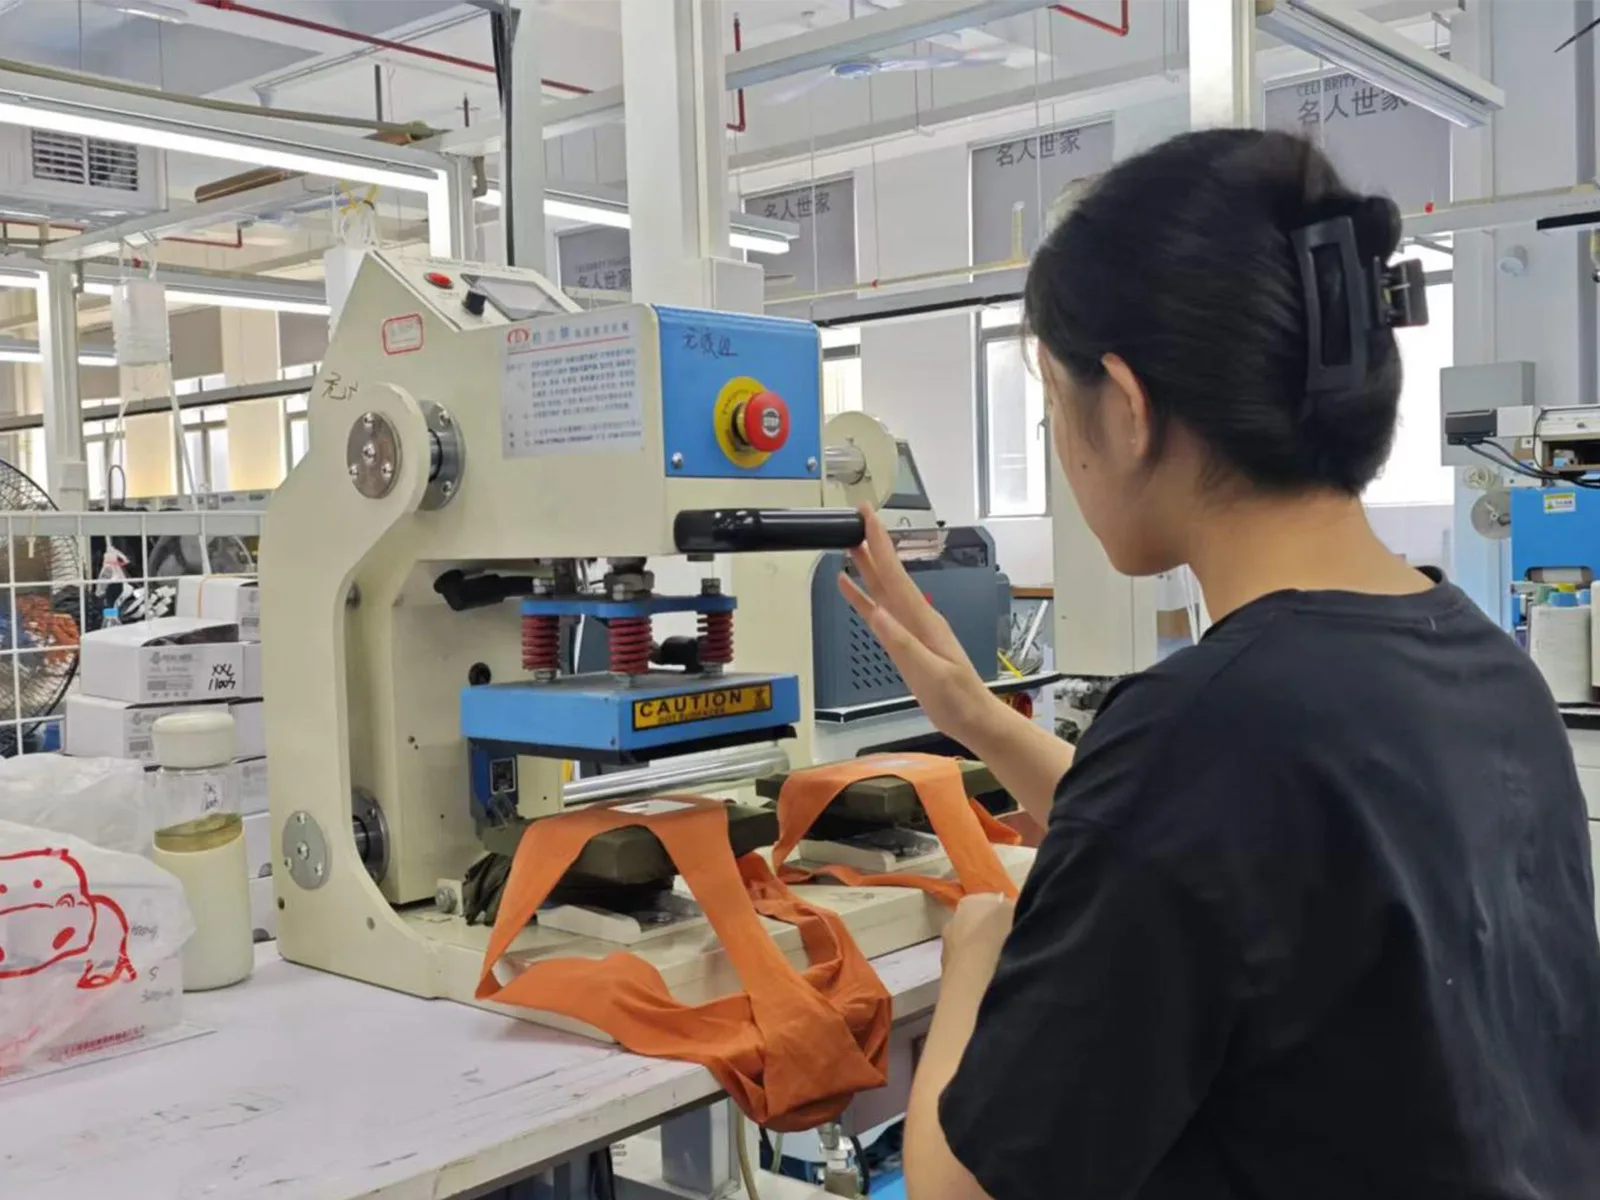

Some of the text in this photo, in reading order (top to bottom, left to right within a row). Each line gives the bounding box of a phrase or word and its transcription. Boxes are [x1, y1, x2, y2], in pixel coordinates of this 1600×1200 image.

[1298, 86, 1408, 125] 名人世家
[996, 128, 1081, 168] 名人世家
[764, 191, 831, 220] 名人世家
[211, 663, 235, 677] XXL
[639, 690, 742, 717] CAUTION
